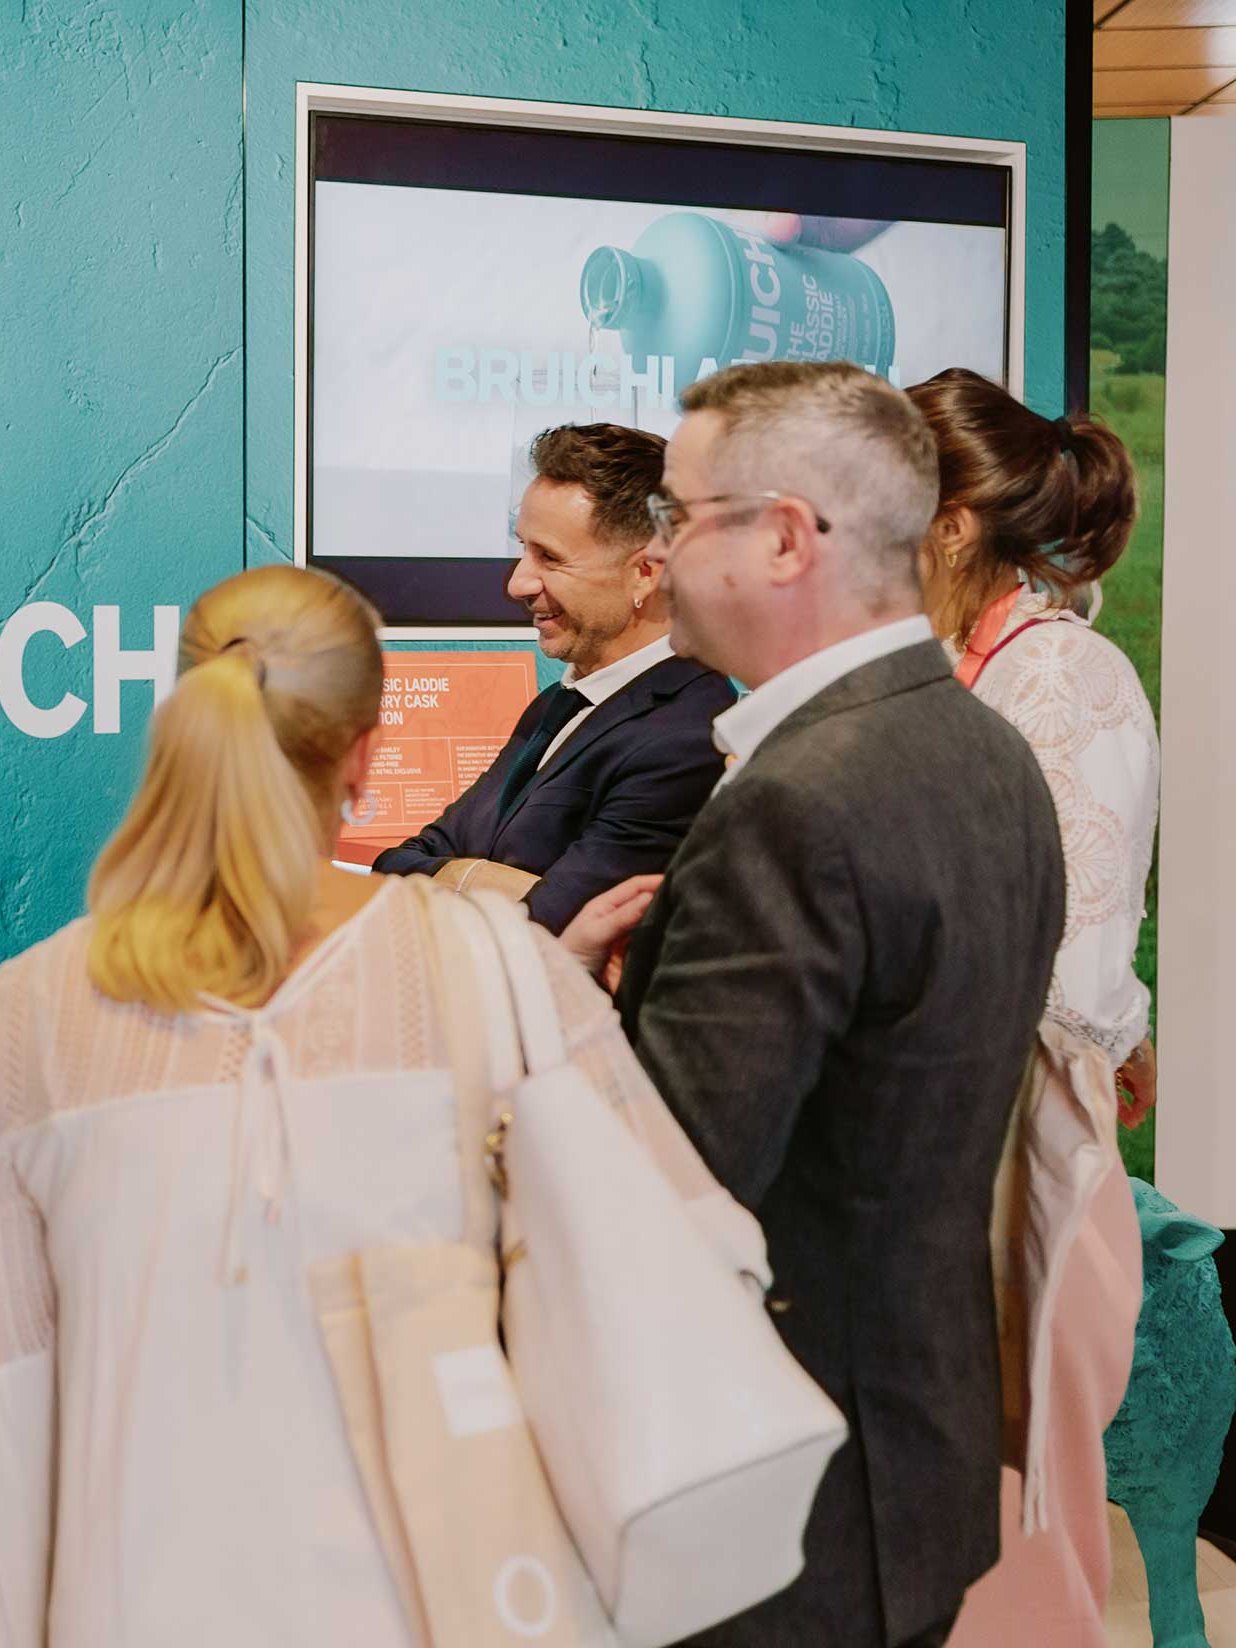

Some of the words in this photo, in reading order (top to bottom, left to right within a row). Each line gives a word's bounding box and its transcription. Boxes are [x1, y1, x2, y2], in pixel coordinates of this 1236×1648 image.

[801, 272, 823, 362] LASSIC
[785, 321, 806, 360] HE
[405, 677, 450, 692] LADDIE
[404, 694, 439, 709] CASK
